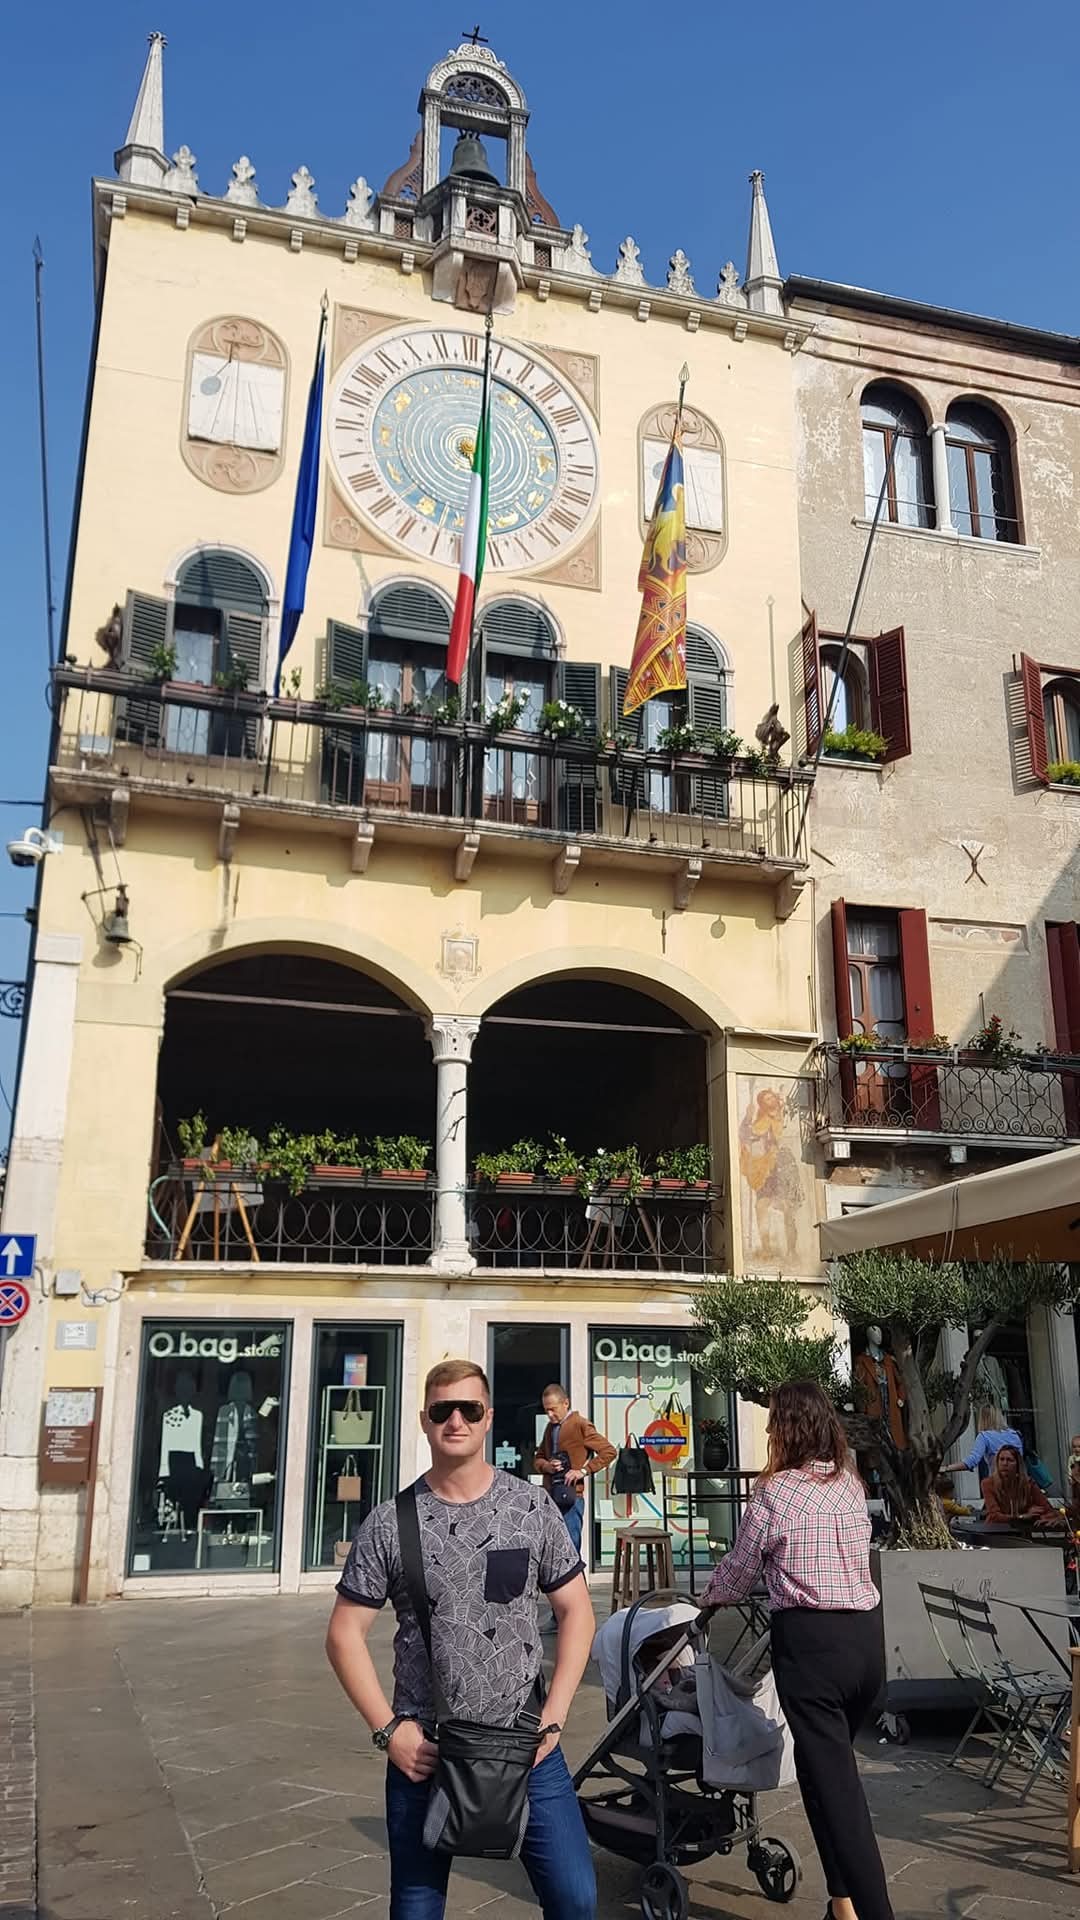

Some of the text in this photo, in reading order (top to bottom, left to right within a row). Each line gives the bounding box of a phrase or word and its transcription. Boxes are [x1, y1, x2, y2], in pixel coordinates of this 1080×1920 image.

[149, 1332, 174, 1357] O
[180, 1331, 238, 1363] bag
[595, 1338, 617, 1361] O
[621, 1338, 671, 1368] bag
